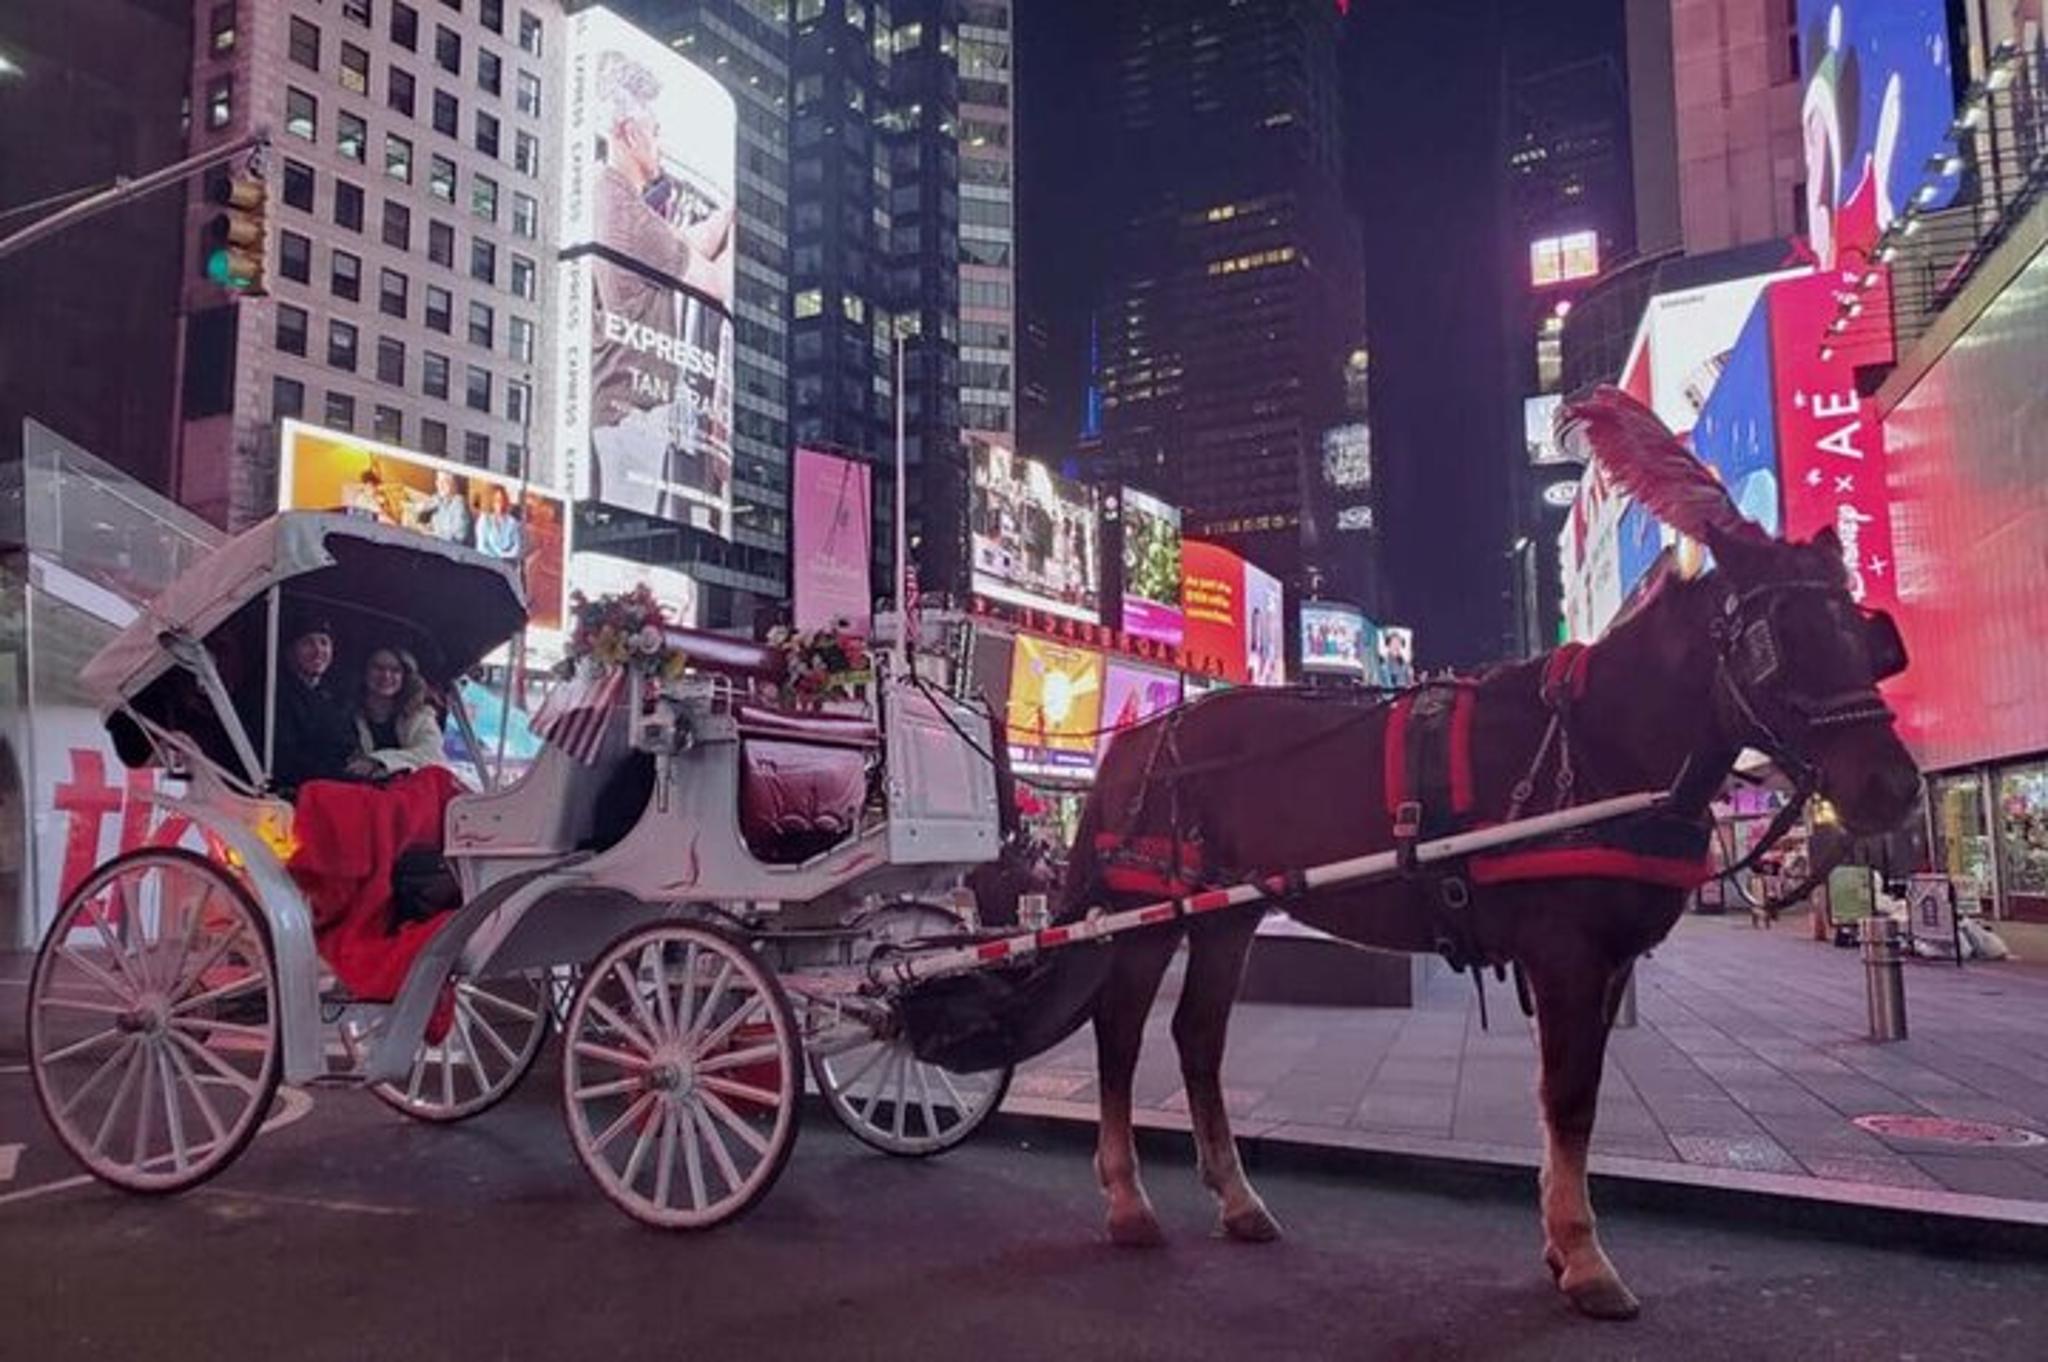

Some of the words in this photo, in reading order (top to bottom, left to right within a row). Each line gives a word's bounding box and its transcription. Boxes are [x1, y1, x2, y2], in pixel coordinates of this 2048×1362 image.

[605, 311, 716, 379] EXPRESS
[628, 366, 670, 402] TAN
[1811, 388, 1866, 460] AE
